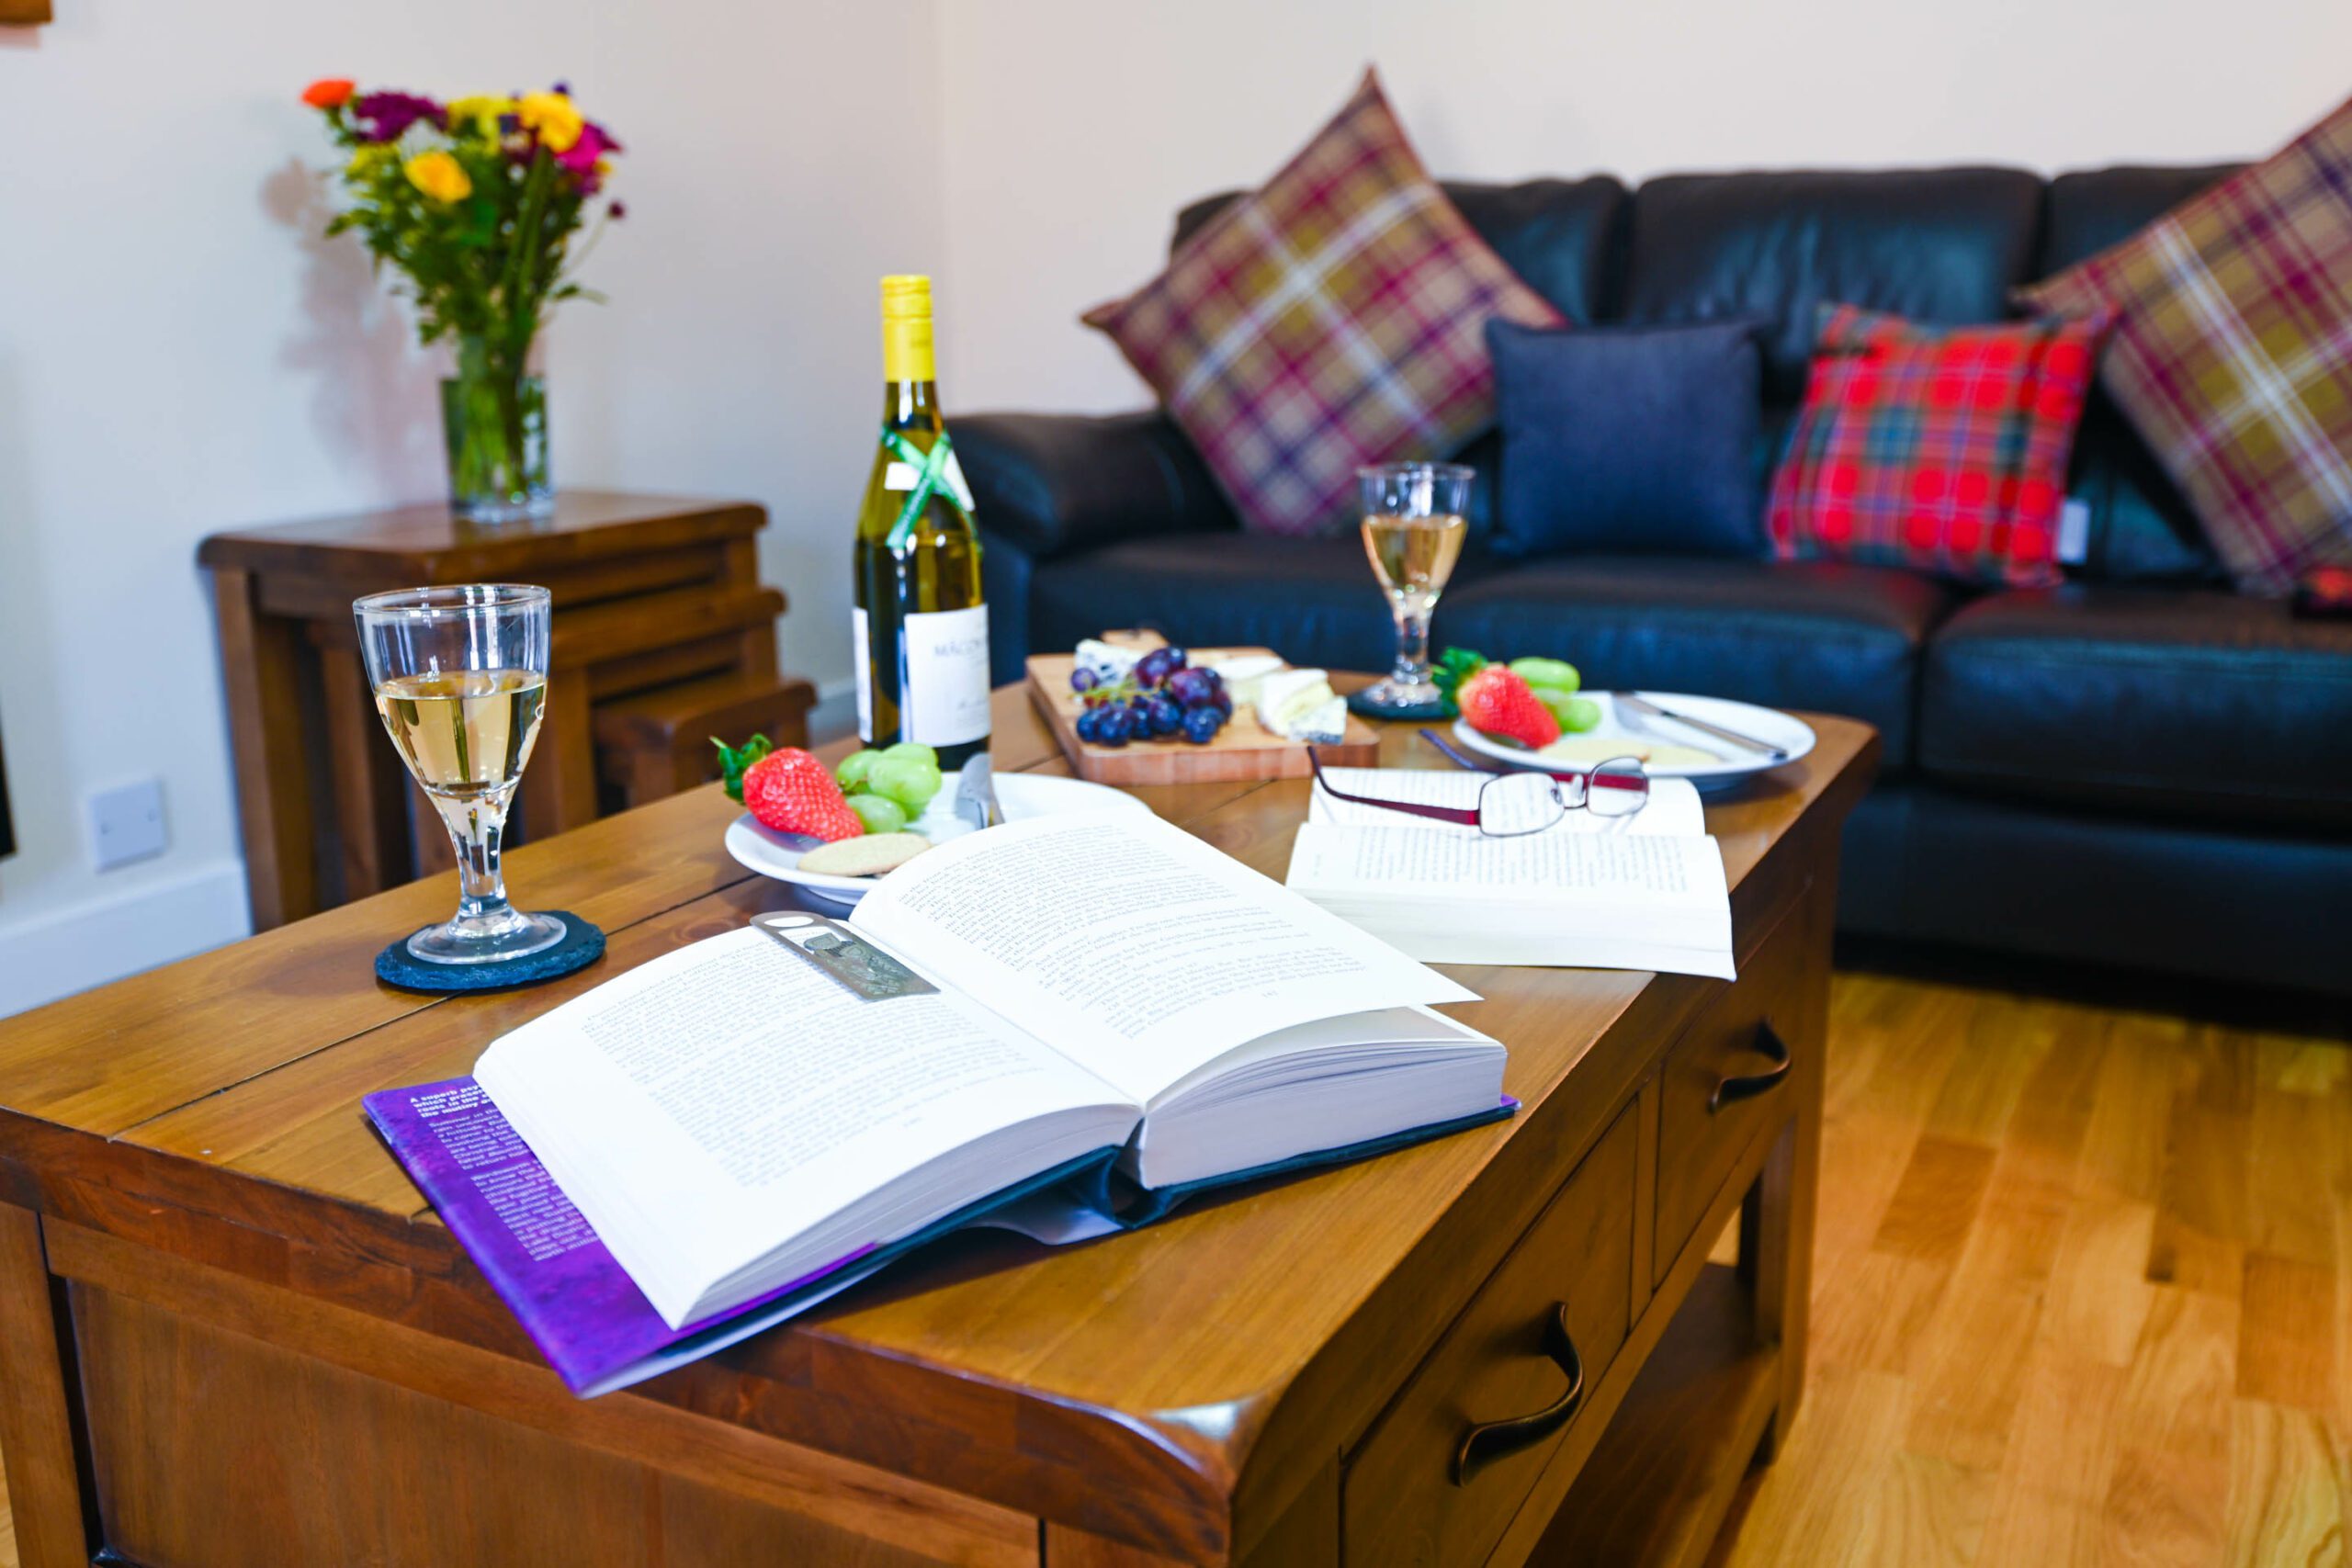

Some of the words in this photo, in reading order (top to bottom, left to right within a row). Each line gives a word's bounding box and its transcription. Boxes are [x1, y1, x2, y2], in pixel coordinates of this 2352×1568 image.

[421, 1090, 458, 1100] superb
[413, 1099, 447, 1107] which
[418, 1104, 445, 1112] roots
[442, 1102, 478, 1113] mutiny
[429, 1116, 470, 1127] Summer
[456, 1114, 499, 1128] uncovers
